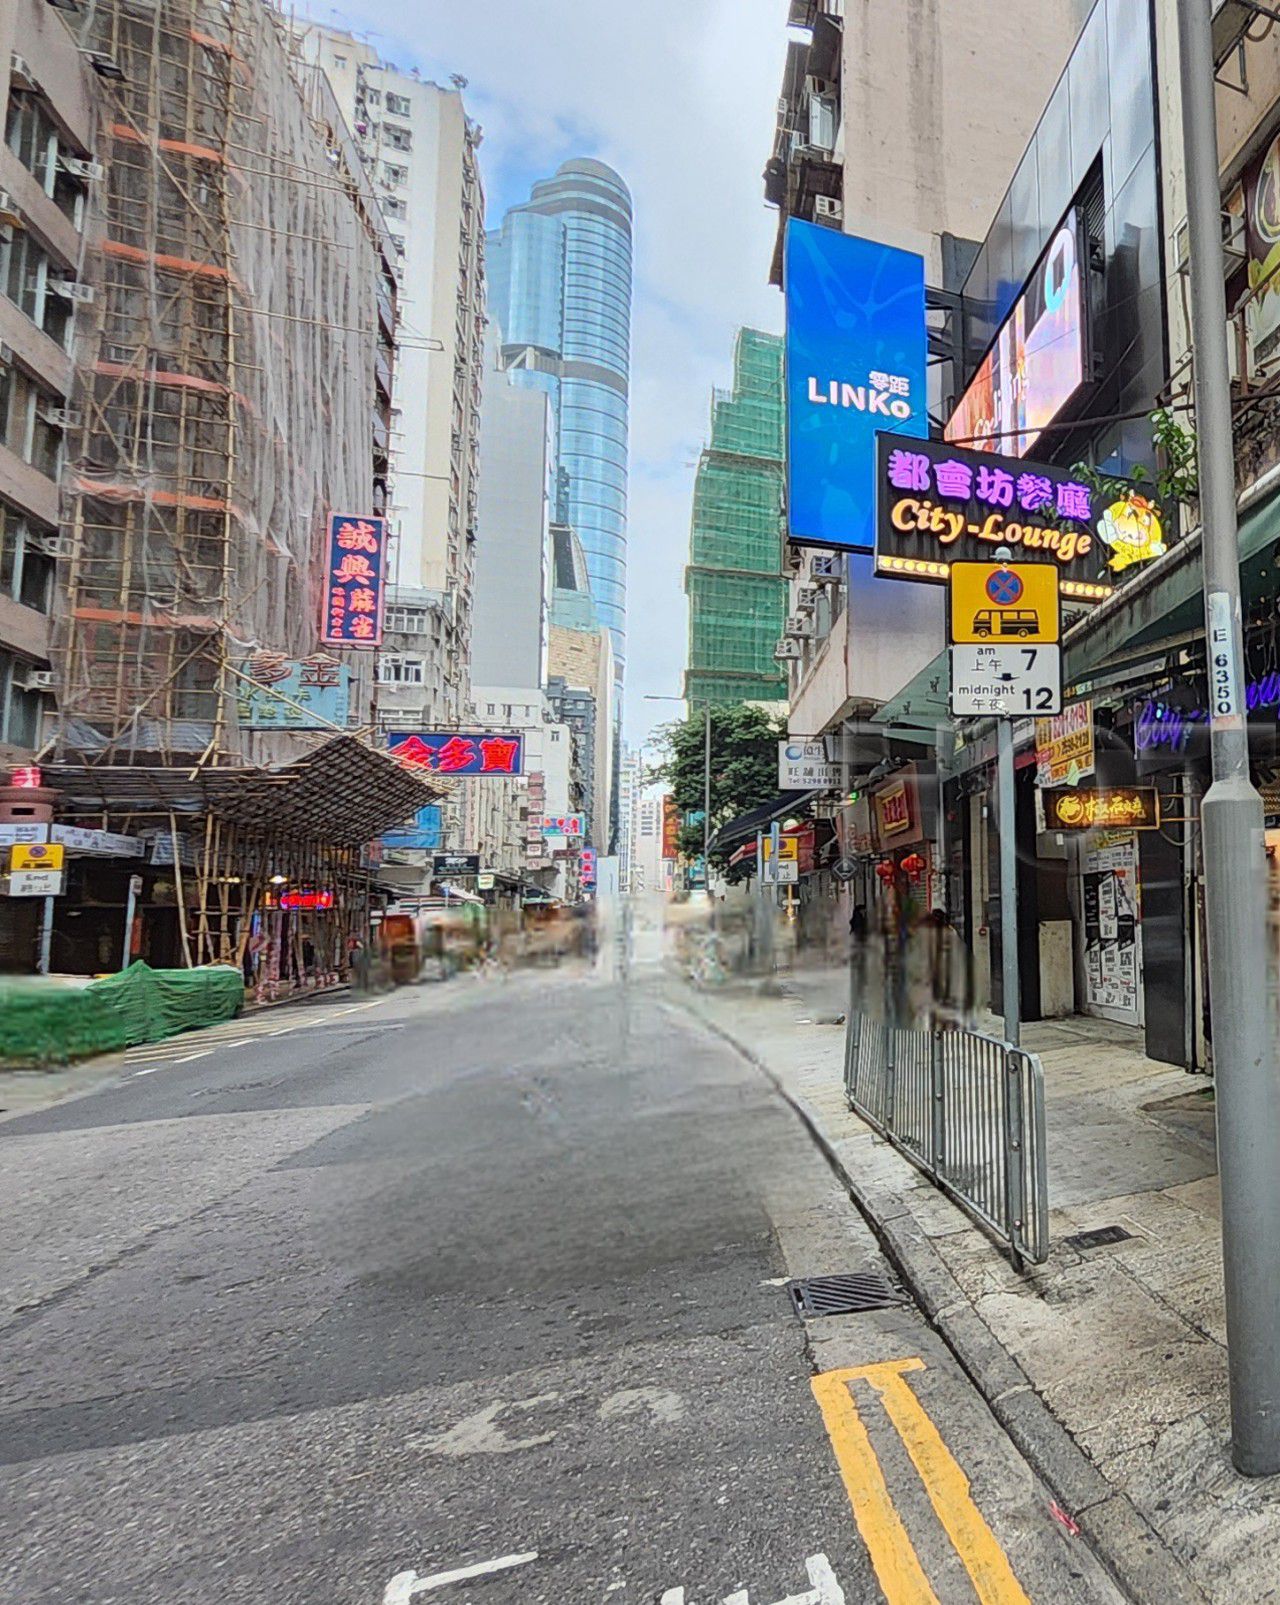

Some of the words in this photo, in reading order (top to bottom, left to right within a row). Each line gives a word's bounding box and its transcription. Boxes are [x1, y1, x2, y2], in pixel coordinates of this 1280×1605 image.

[868, 370, 910, 397] 零距
[888, 448, 1092, 521] 都會坊餐廳
[1213, 629, 1227, 642] E
[971, 657, 1002, 674] 上午
[976, 647, 996, 657] am
[1021, 648, 1038, 672] 7
[958, 683, 1016, 699] midnight
[1023, 687, 1053, 711] 12
[1214, 653, 1232, 715] 6350
